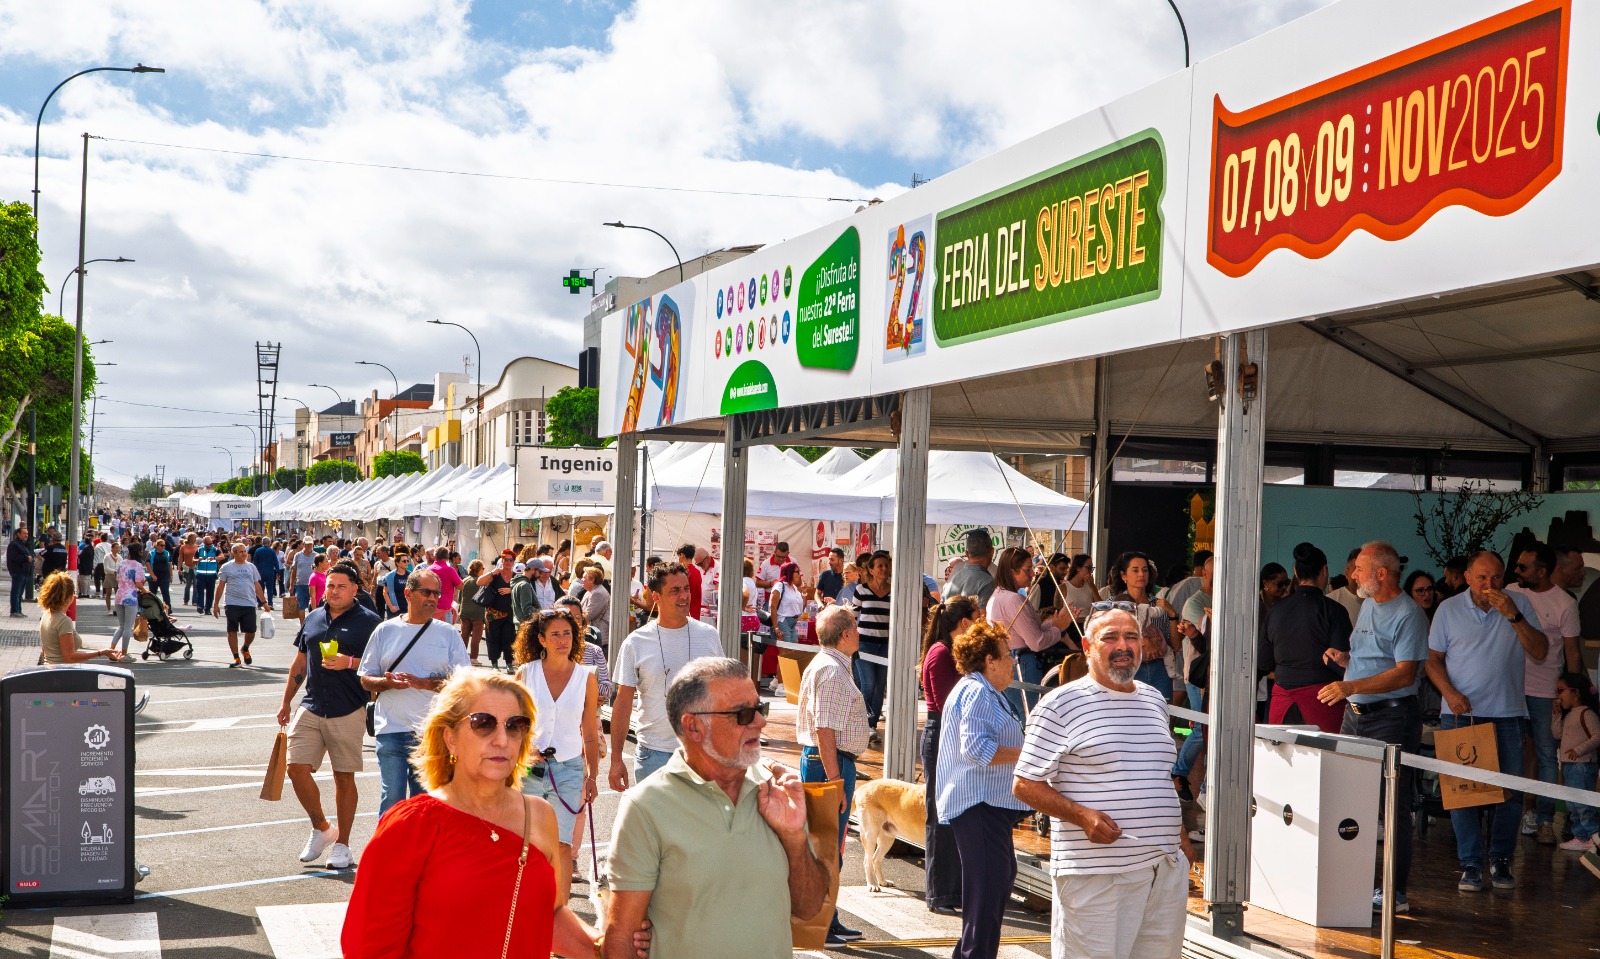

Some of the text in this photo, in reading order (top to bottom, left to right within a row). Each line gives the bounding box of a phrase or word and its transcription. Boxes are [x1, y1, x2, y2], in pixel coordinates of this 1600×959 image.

[942, 169, 1149, 311] FERIA DEL SURESTE
[847, 256, 857, 281] de
[799, 300, 823, 323] nuestra
[837, 287, 856, 314] Feria
[812, 318, 855, 349] del Sureste!!
[540, 455, 613, 474] Ingenio
[941, 535, 1000, 557] INGO
[21, 717, 47, 875] SMART
